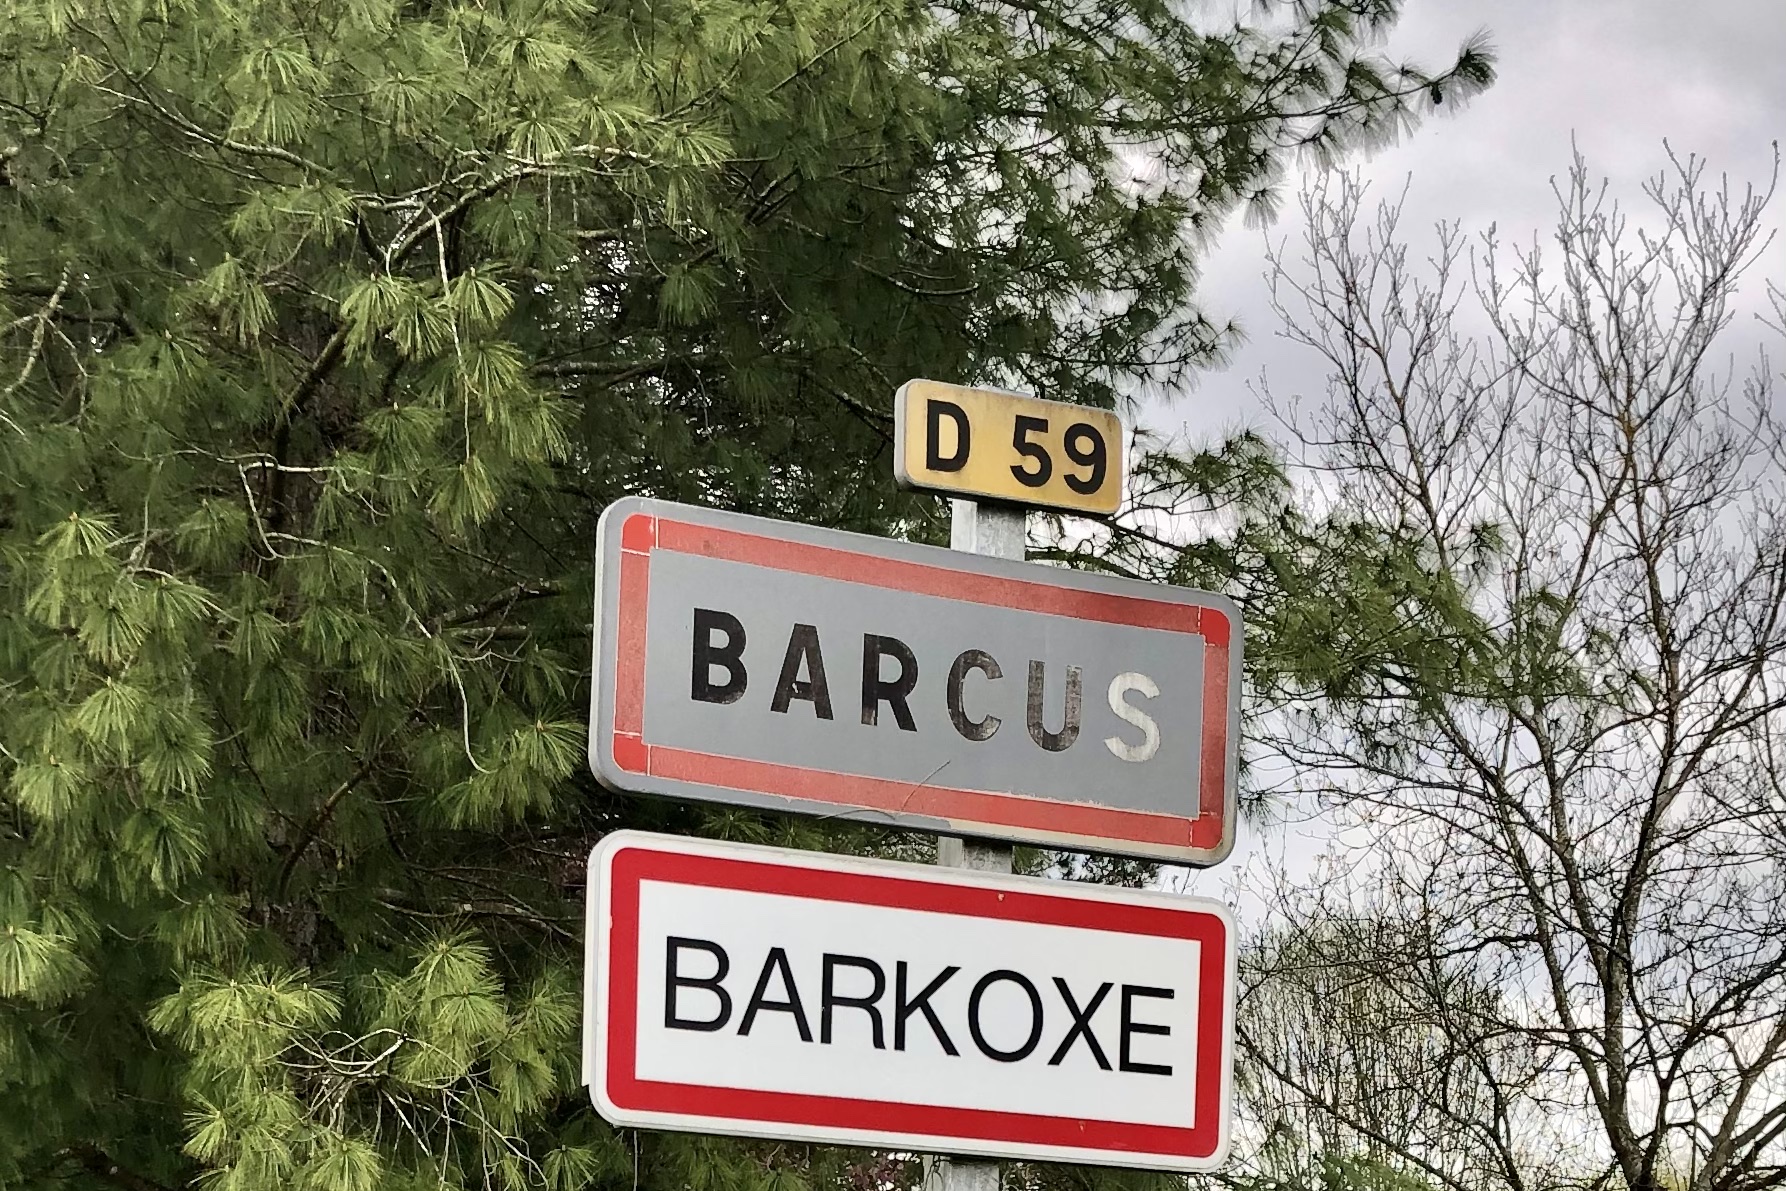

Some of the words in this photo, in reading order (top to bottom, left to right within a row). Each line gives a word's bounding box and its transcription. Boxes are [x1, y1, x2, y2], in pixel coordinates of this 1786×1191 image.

[926, 399, 970, 472] D
[1010, 414, 1107, 495] 59
[691, 607, 1162, 763] BARCUS
[664, 936, 1175, 1076] BARKOXE
